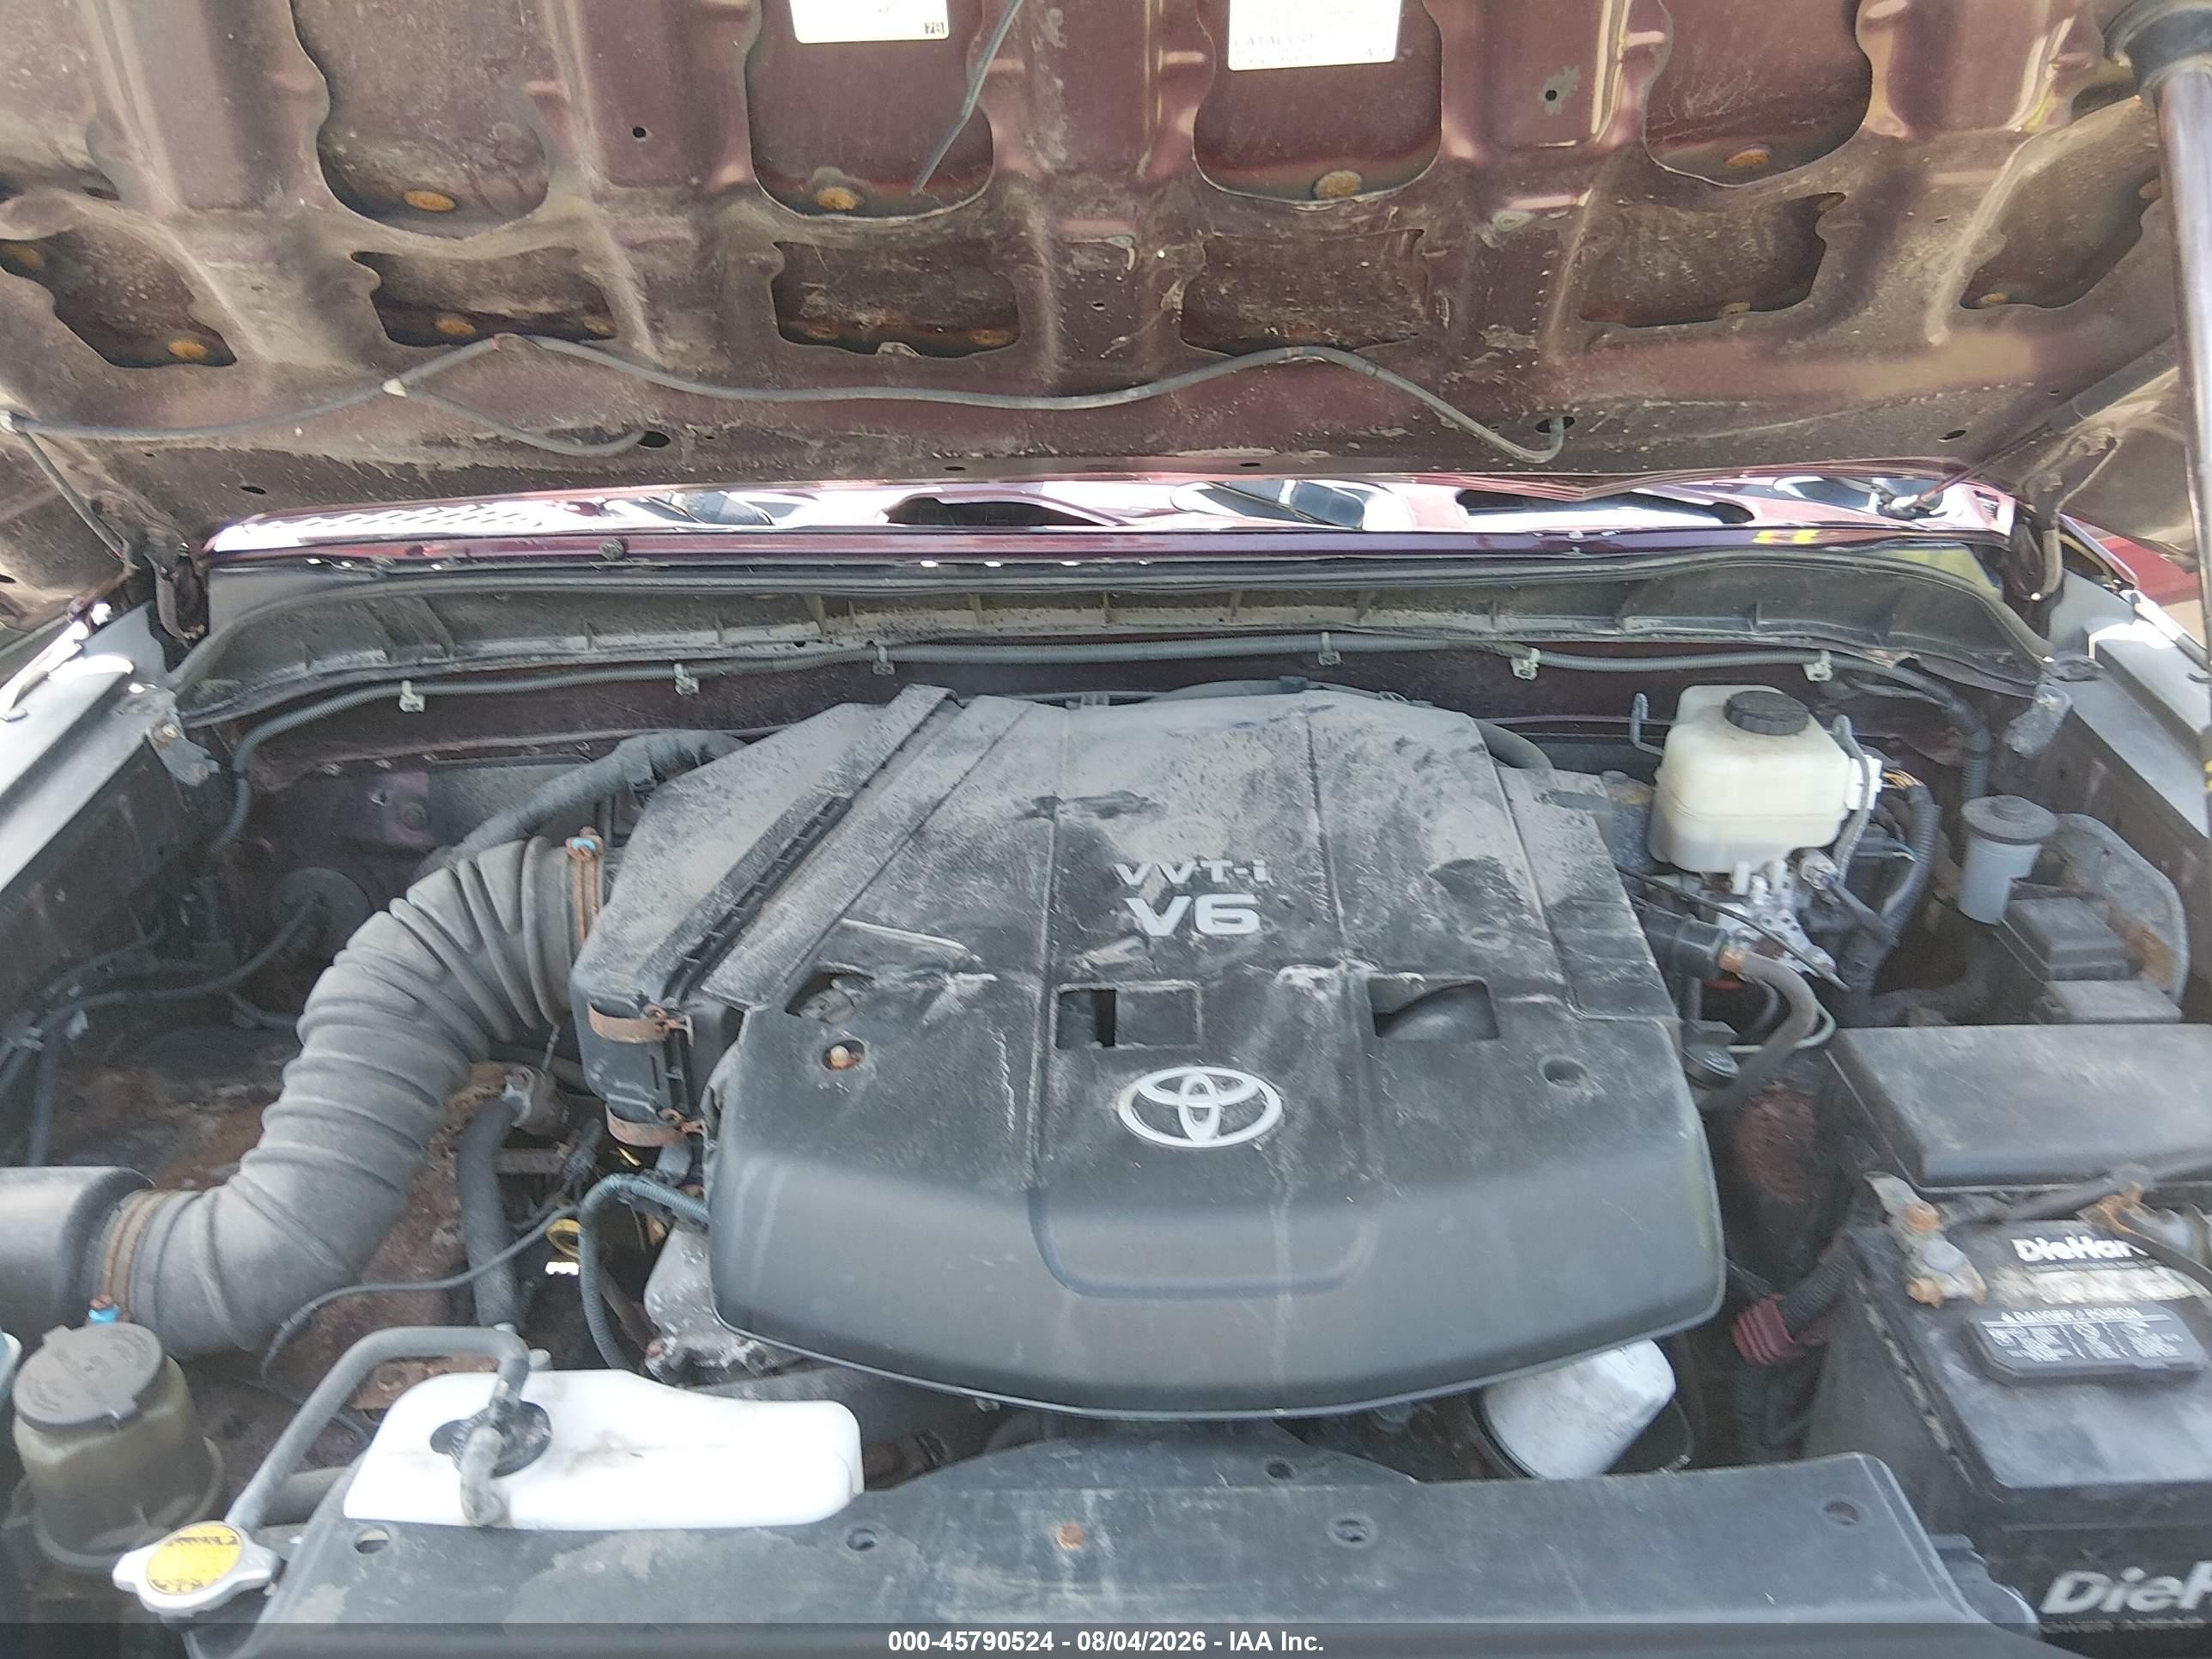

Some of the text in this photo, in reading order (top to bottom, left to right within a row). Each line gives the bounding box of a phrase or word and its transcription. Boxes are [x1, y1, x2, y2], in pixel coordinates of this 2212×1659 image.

[1113, 860, 1267, 886] VVT-i
[1124, 893, 1261, 937] V6
[2011, 1236, 2148, 1261] DieHar
[2013, 1307, 2145, 1323] DANGER POISON
